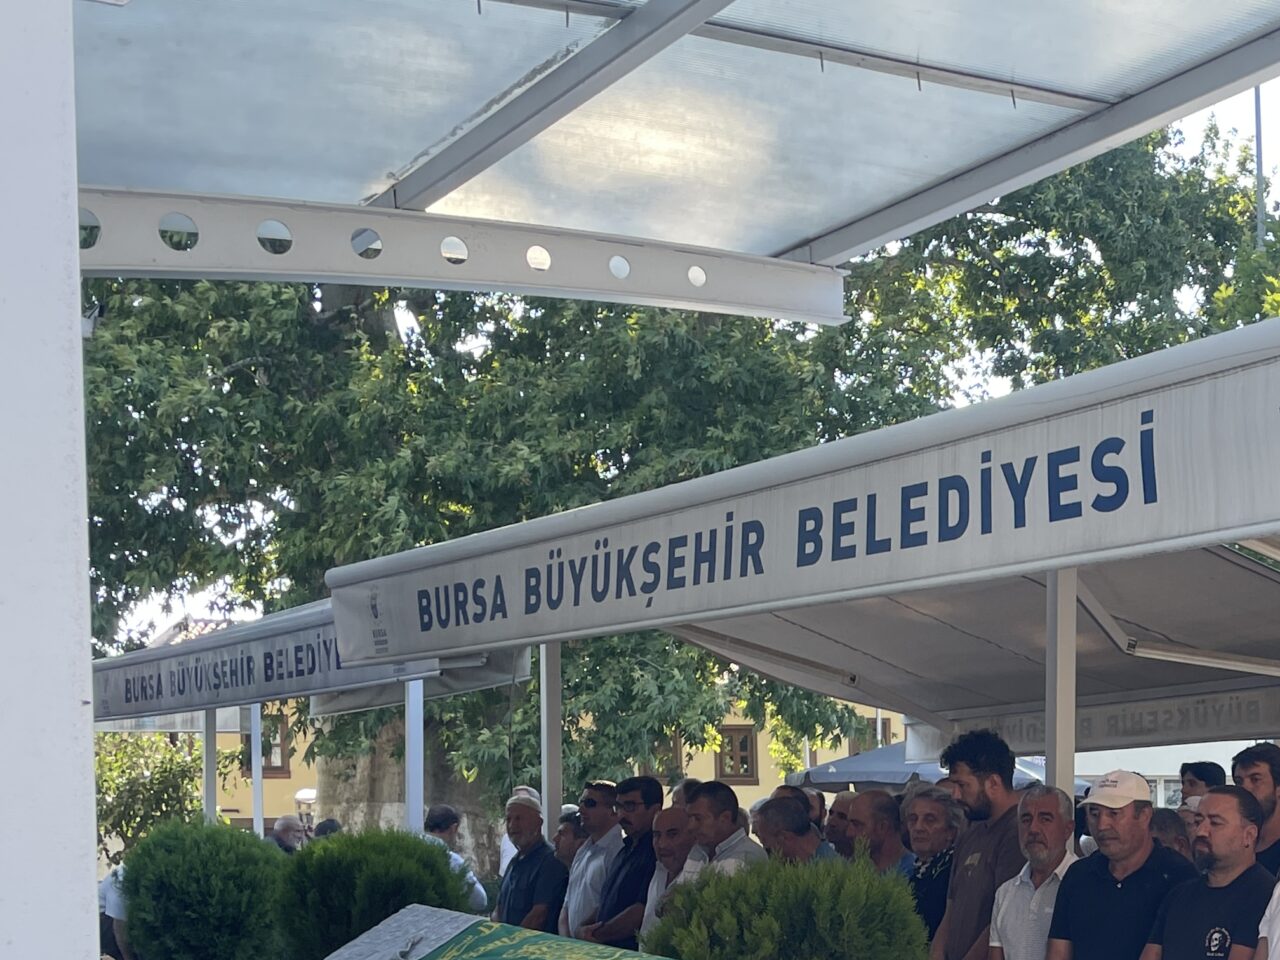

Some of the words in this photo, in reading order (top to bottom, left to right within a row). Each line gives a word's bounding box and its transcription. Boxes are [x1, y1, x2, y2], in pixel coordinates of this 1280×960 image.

[417, 576, 508, 632] BURSA
[523, 511, 765, 616] BÜYÜKŞEHİR
[796, 409, 1158, 567] BELEDİYESİ
[125, 672, 163, 703] BURSA
[169, 651, 255, 697] BÜYÜKŞEHİR
[263, 633, 341, 682] BELEDİY
